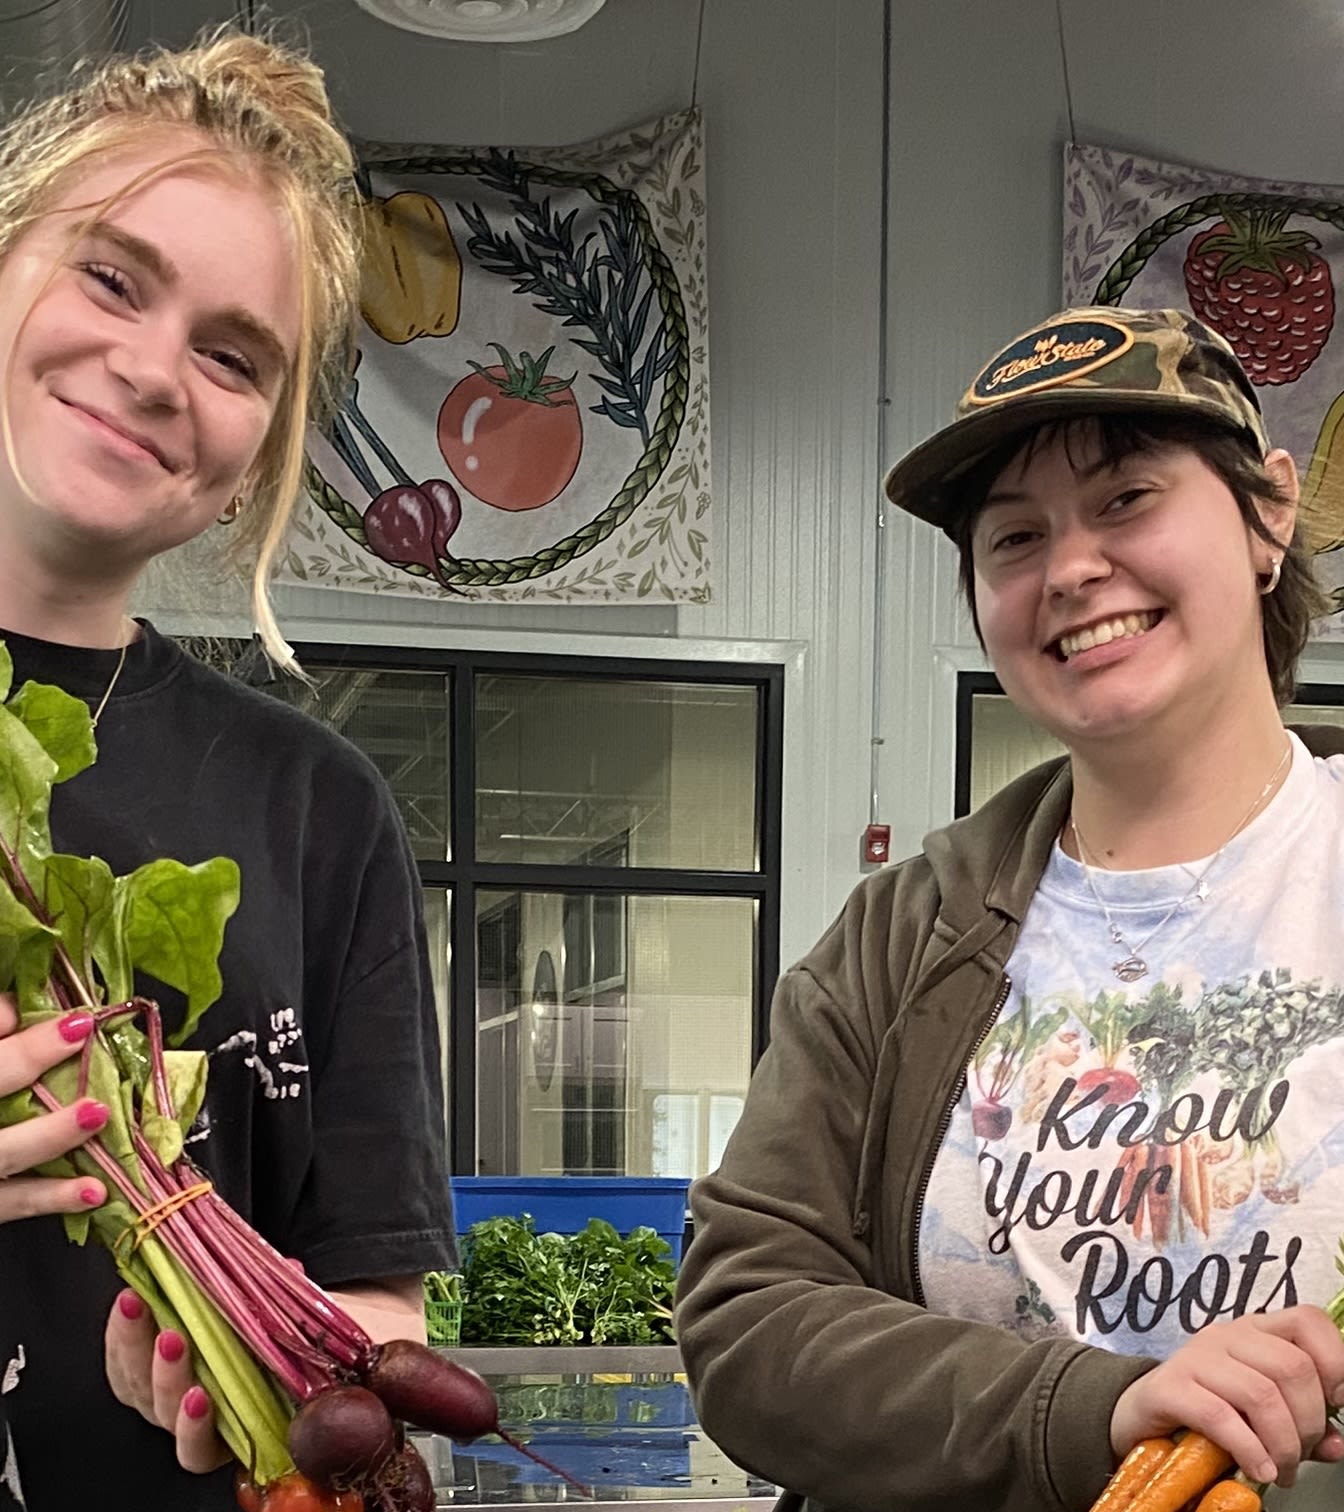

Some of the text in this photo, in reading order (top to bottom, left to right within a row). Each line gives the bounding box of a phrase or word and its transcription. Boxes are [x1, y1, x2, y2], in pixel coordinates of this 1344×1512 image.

[1036, 1077, 1290, 1155] Know
[977, 1150, 1172, 1255] Your
[1060, 1230, 1303, 1335] Roots
